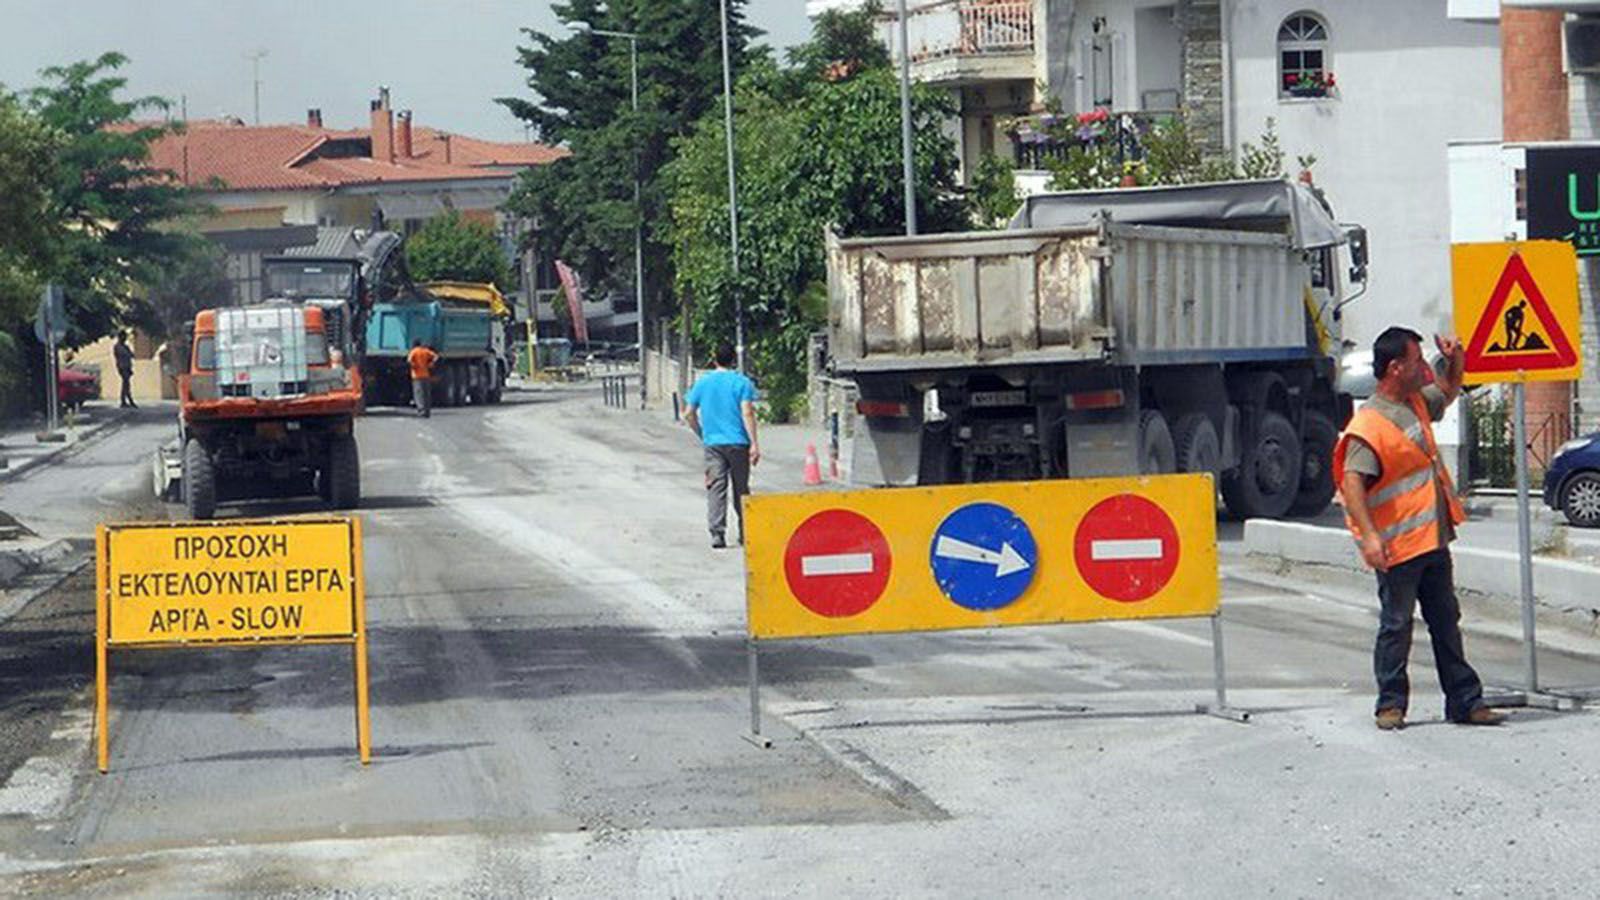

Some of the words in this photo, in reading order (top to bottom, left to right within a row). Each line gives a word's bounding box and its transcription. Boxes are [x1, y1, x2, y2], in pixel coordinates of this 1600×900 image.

[174, 534, 288, 560] ΠΡΟΣΟΧΗ
[119, 571, 278, 598] ΕΚΤΕΛΟΥΝΤΑΙ
[286, 568, 344, 593] ΕΡΓΑ
[231, 605, 304, 631] SLOW
